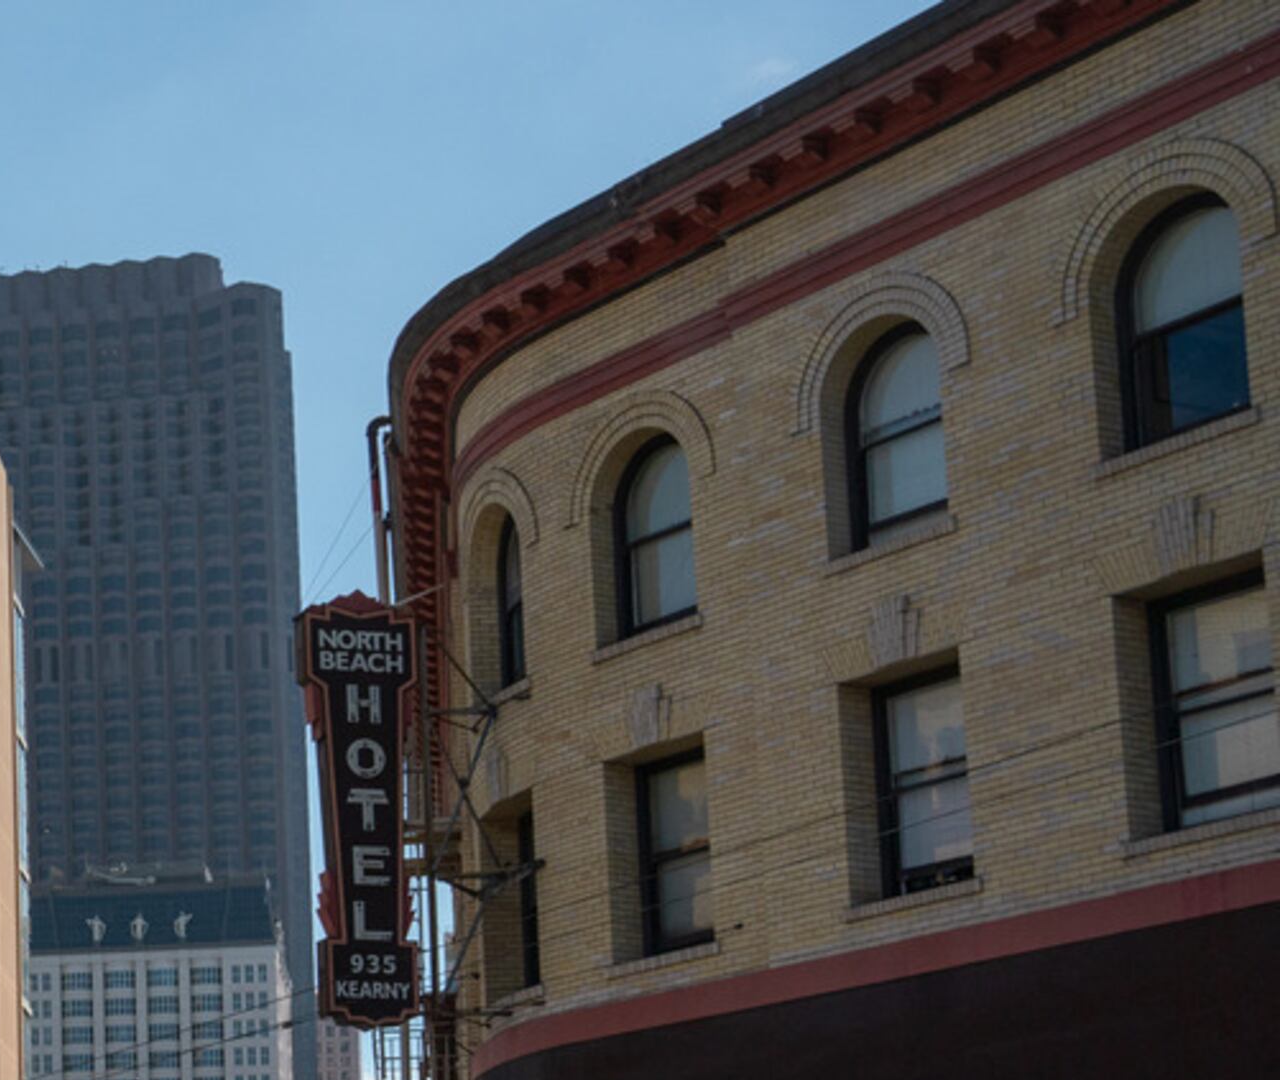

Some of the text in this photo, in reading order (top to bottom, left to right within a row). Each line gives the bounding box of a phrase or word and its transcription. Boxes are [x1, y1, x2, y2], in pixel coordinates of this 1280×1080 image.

[318, 628, 403, 651] NORTH
[319, 650, 404, 674] BEACH
[346, 683, 394, 941] HOTEL
[350, 953, 397, 975] 935
[336, 980, 410, 999] KEARNY
